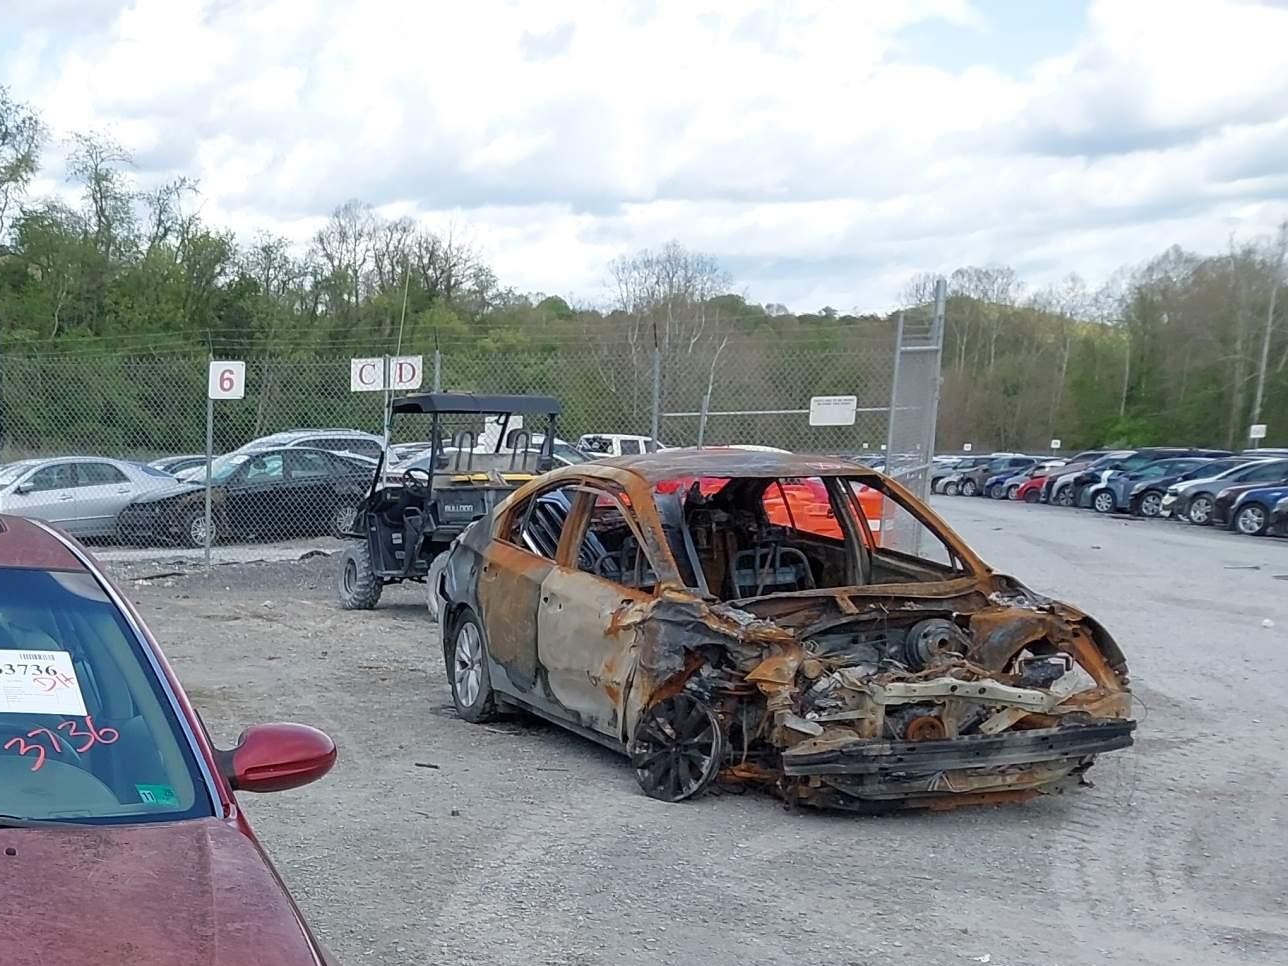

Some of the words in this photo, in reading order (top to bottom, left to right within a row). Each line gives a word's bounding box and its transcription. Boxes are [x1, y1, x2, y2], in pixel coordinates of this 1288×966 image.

[219, 369, 234, 392] 6
[359, 364, 376, 385] C
[397, 362, 416, 384] D
[4, 715, 120, 772] 3736
